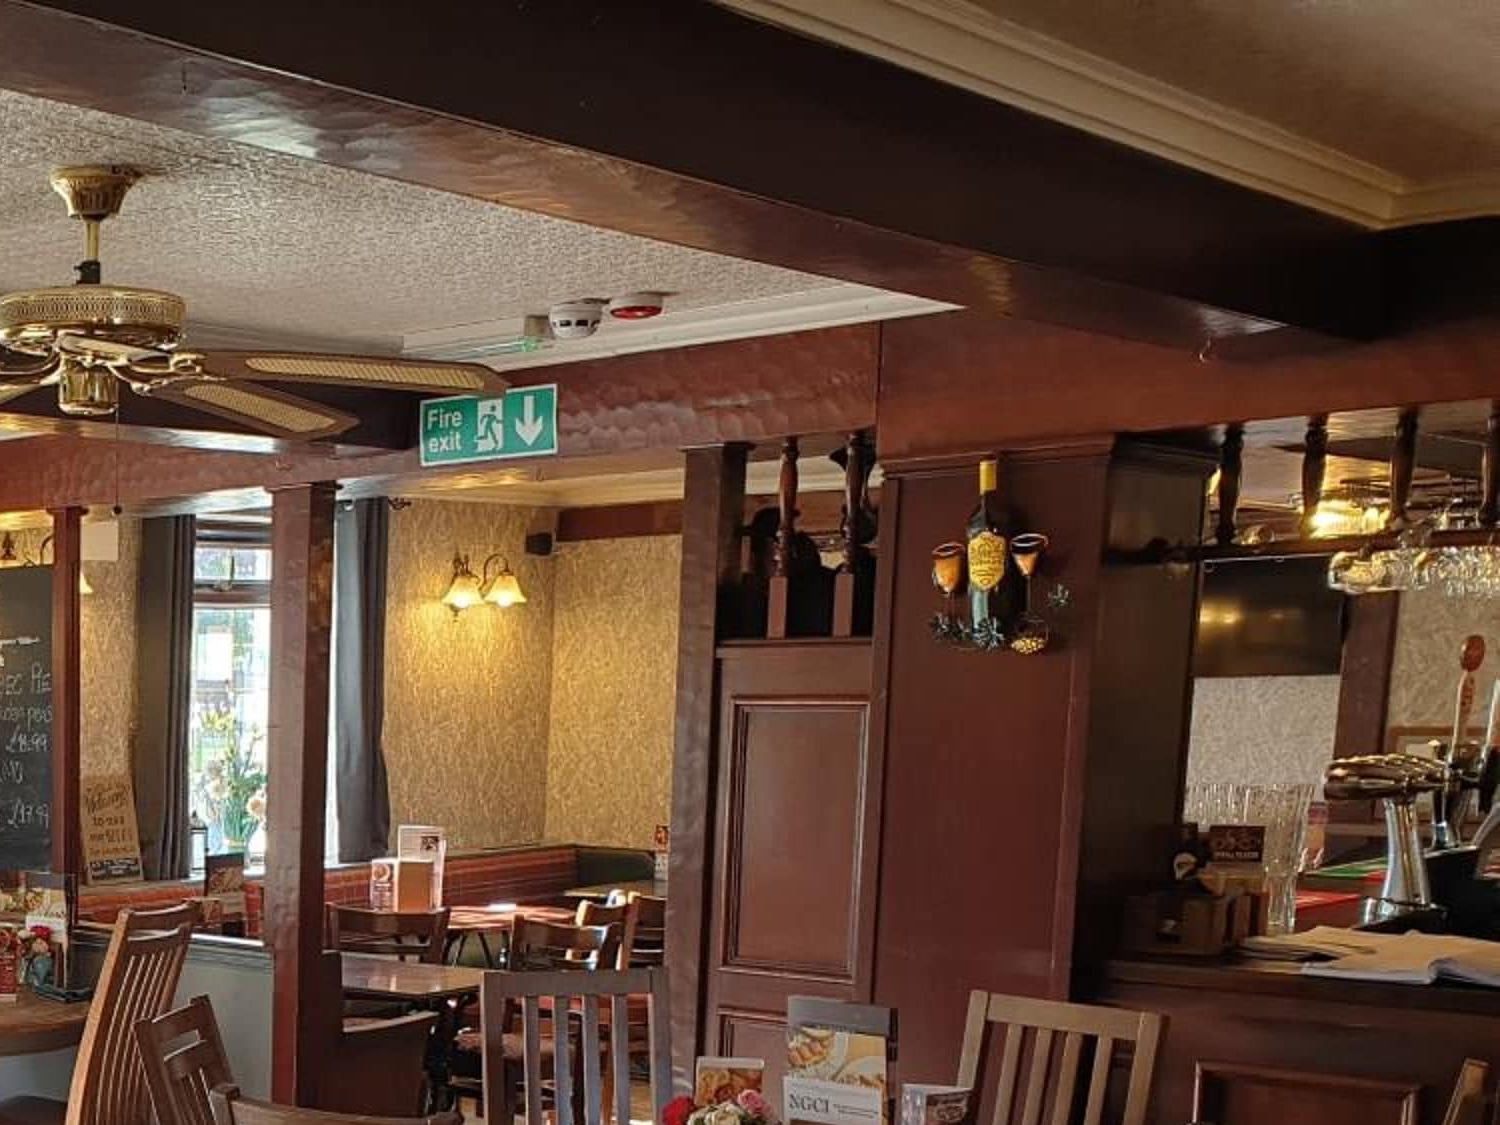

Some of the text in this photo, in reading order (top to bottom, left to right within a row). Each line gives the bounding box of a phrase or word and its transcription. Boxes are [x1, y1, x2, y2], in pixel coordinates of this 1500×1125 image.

[427, 408, 463, 430] Fire
[428, 431, 462, 453] exit
[789, 1093, 830, 1114] NGCI
